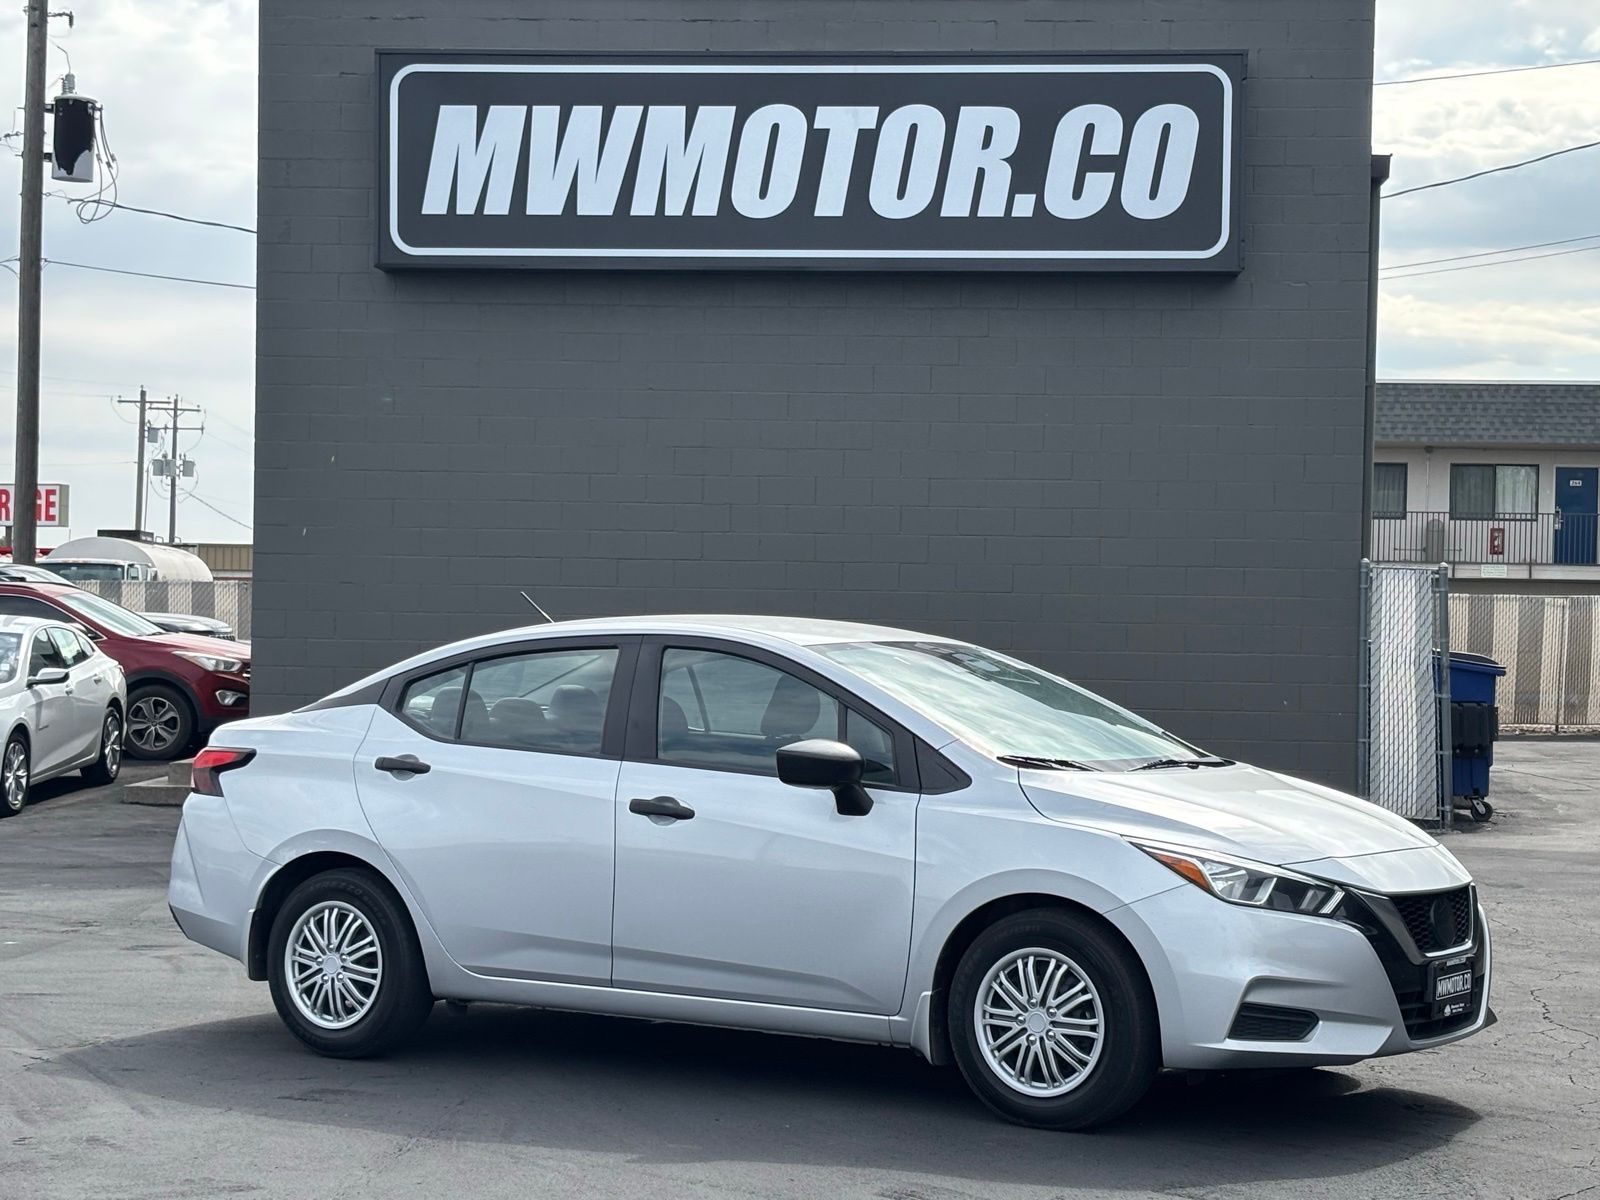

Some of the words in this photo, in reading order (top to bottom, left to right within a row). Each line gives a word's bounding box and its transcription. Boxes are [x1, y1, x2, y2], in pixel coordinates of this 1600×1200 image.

[421, 103, 1200, 220] MWMOTOR.CO
[0, 489, 57, 521] RGE
[1437, 973, 1471, 997] MWMOTOR.CO
